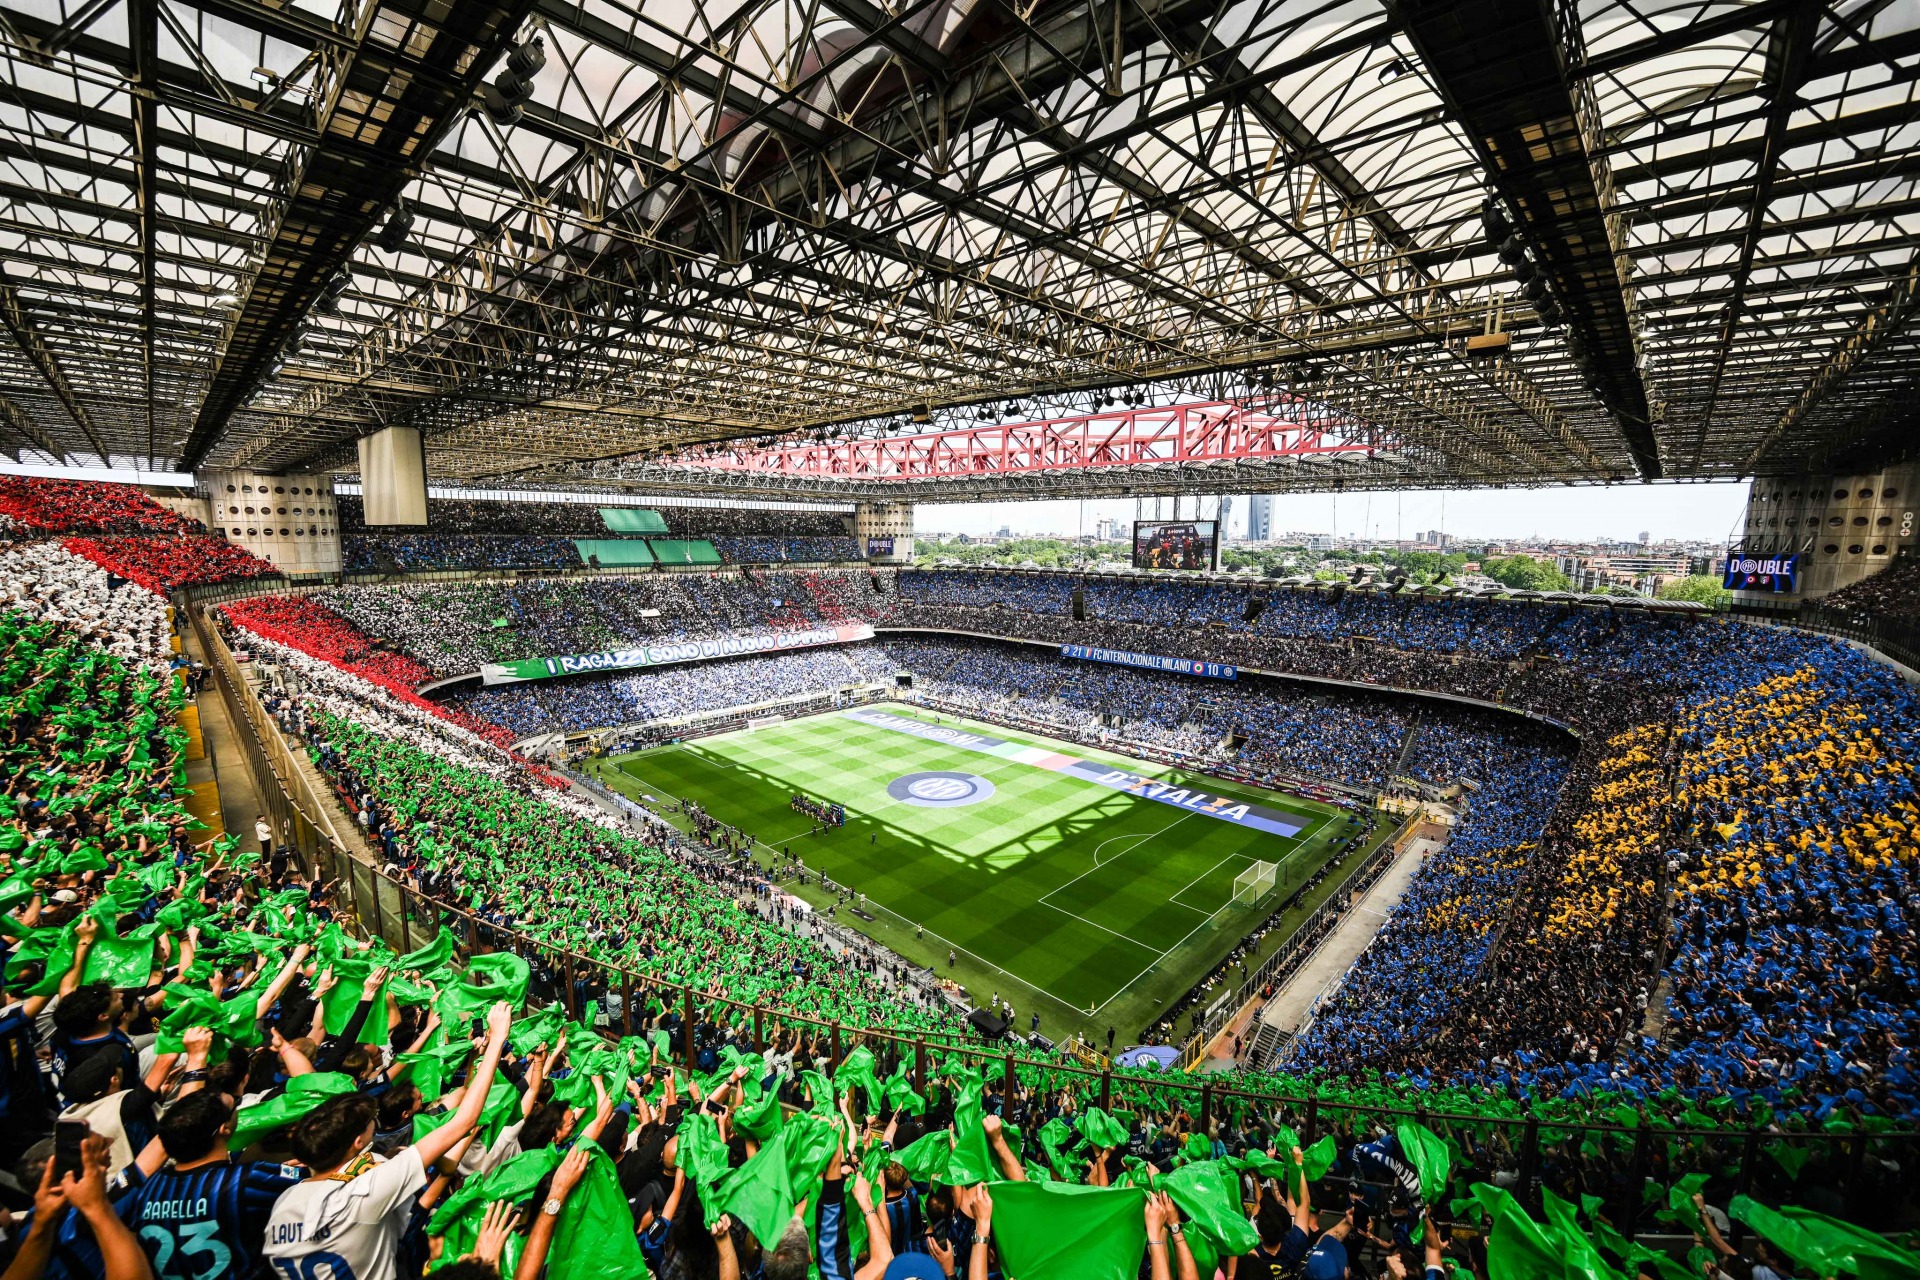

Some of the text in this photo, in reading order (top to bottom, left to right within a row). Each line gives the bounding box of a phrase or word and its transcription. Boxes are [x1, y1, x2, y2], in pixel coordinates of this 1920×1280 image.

[1730, 559, 1792, 575] DOUBLE
[545, 628, 838, 675] I RAGAZZI SONO DI NUOVO CAMPIONI
[1072, 646, 1219, 676] 21 FC INTERNAZIONALE MILANO 10
[143, 1198, 207, 1220] BARELLA
[272, 1223, 331, 1244] LAUTRO
[140, 1220, 232, 1280] 23
